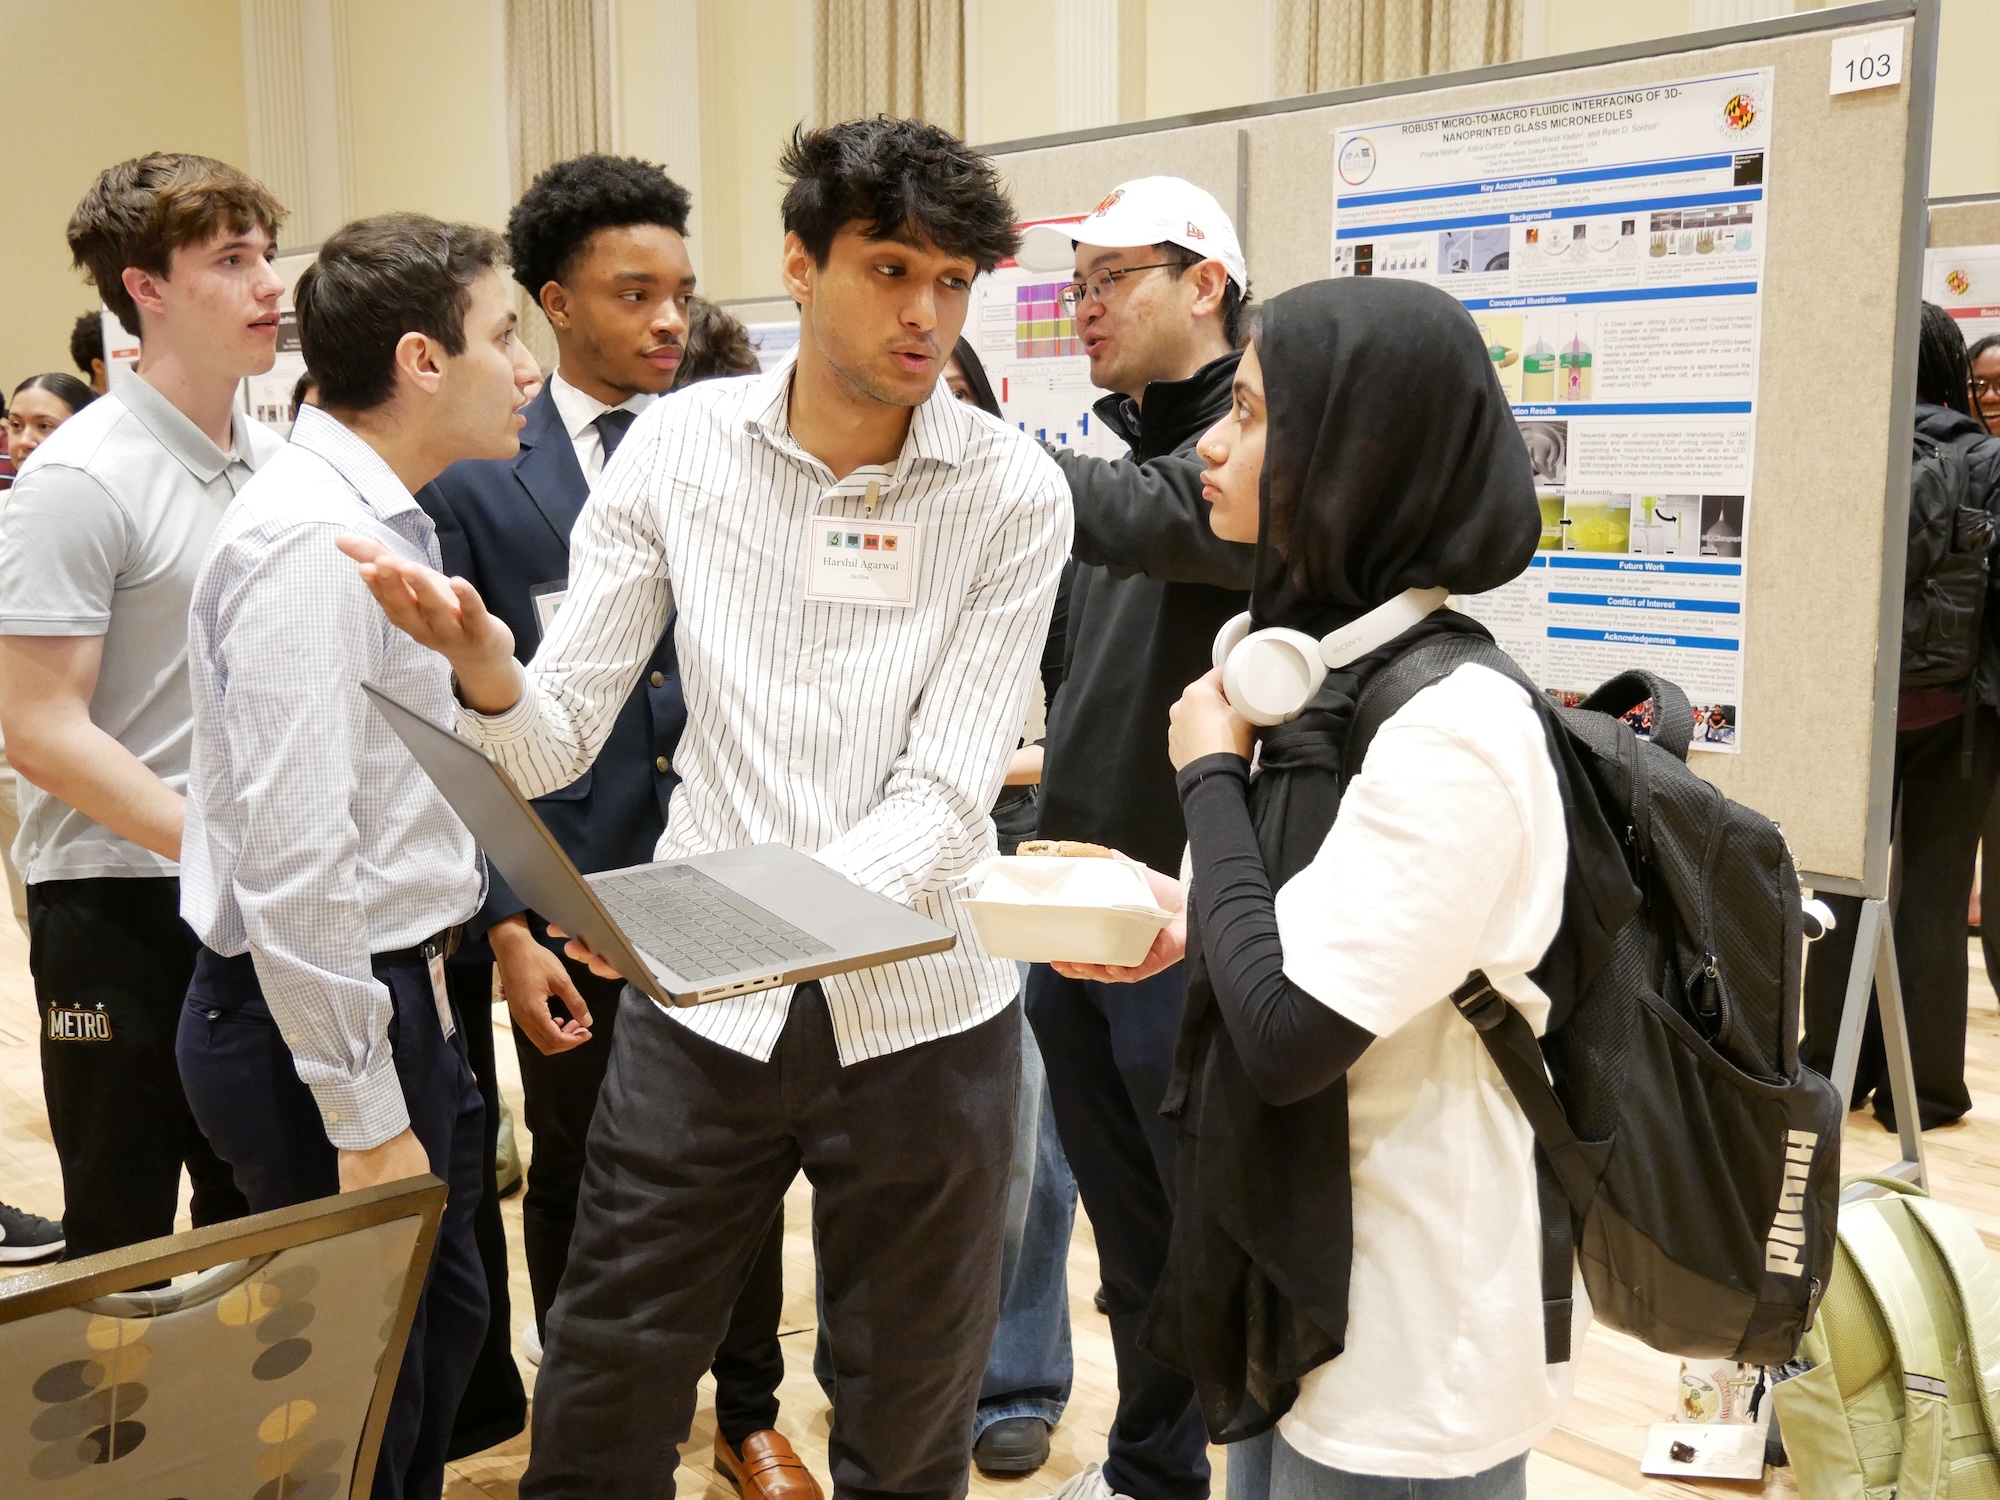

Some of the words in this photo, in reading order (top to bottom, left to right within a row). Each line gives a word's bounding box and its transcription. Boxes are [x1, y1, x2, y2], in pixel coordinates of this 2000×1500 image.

[1845, 53, 1891, 82] 103
[1401, 121, 1439, 135] ROBUST
[1442, 109, 1528, 129] MICRO-TO-MACRO
[1530, 103, 1569, 117] FLUIDIC
[1572, 93, 1643, 112] INTERFACING
[1646, 91, 1661, 101] OF
[1664, 88, 1683, 99] 3D-
[1442, 125, 1511, 143] NANOPRINTED
[1514, 120, 1547, 134] GLASS
[1550, 109, 1633, 129] MICRONEEDLES
[1513, 136, 1541, 147] Kinneret
[1587, 130, 1600, 138] and
[1602, 128, 1620, 137] Ryan
[1622, 126, 1629, 134] D.
[1481, 184, 1493, 193] Key
[1495, 177, 1557, 191] Accomplishments
[1510, 211, 1552, 222] Background
[1489, 298, 1526, 307] Conceptual
[1527, 296, 1566, 305] Illustrations
[822, 557, 858, 568] Harshil
[860, 560, 899, 571] Agarwal
[1619, 562, 1643, 570] Future
[1645, 563, 1665, 571] Work
[1607, 597, 1636, 606] Conflict
[1637, 599, 1646, 607] of
[1647, 600, 1675, 608] Interest
[1332, 634, 1364, 655] SONY
[1604, 632, 1676, 645] Acknowledgements
[50, 1010, 109, 1038] METRO
[1765, 1129, 1818, 1277] PUMA
